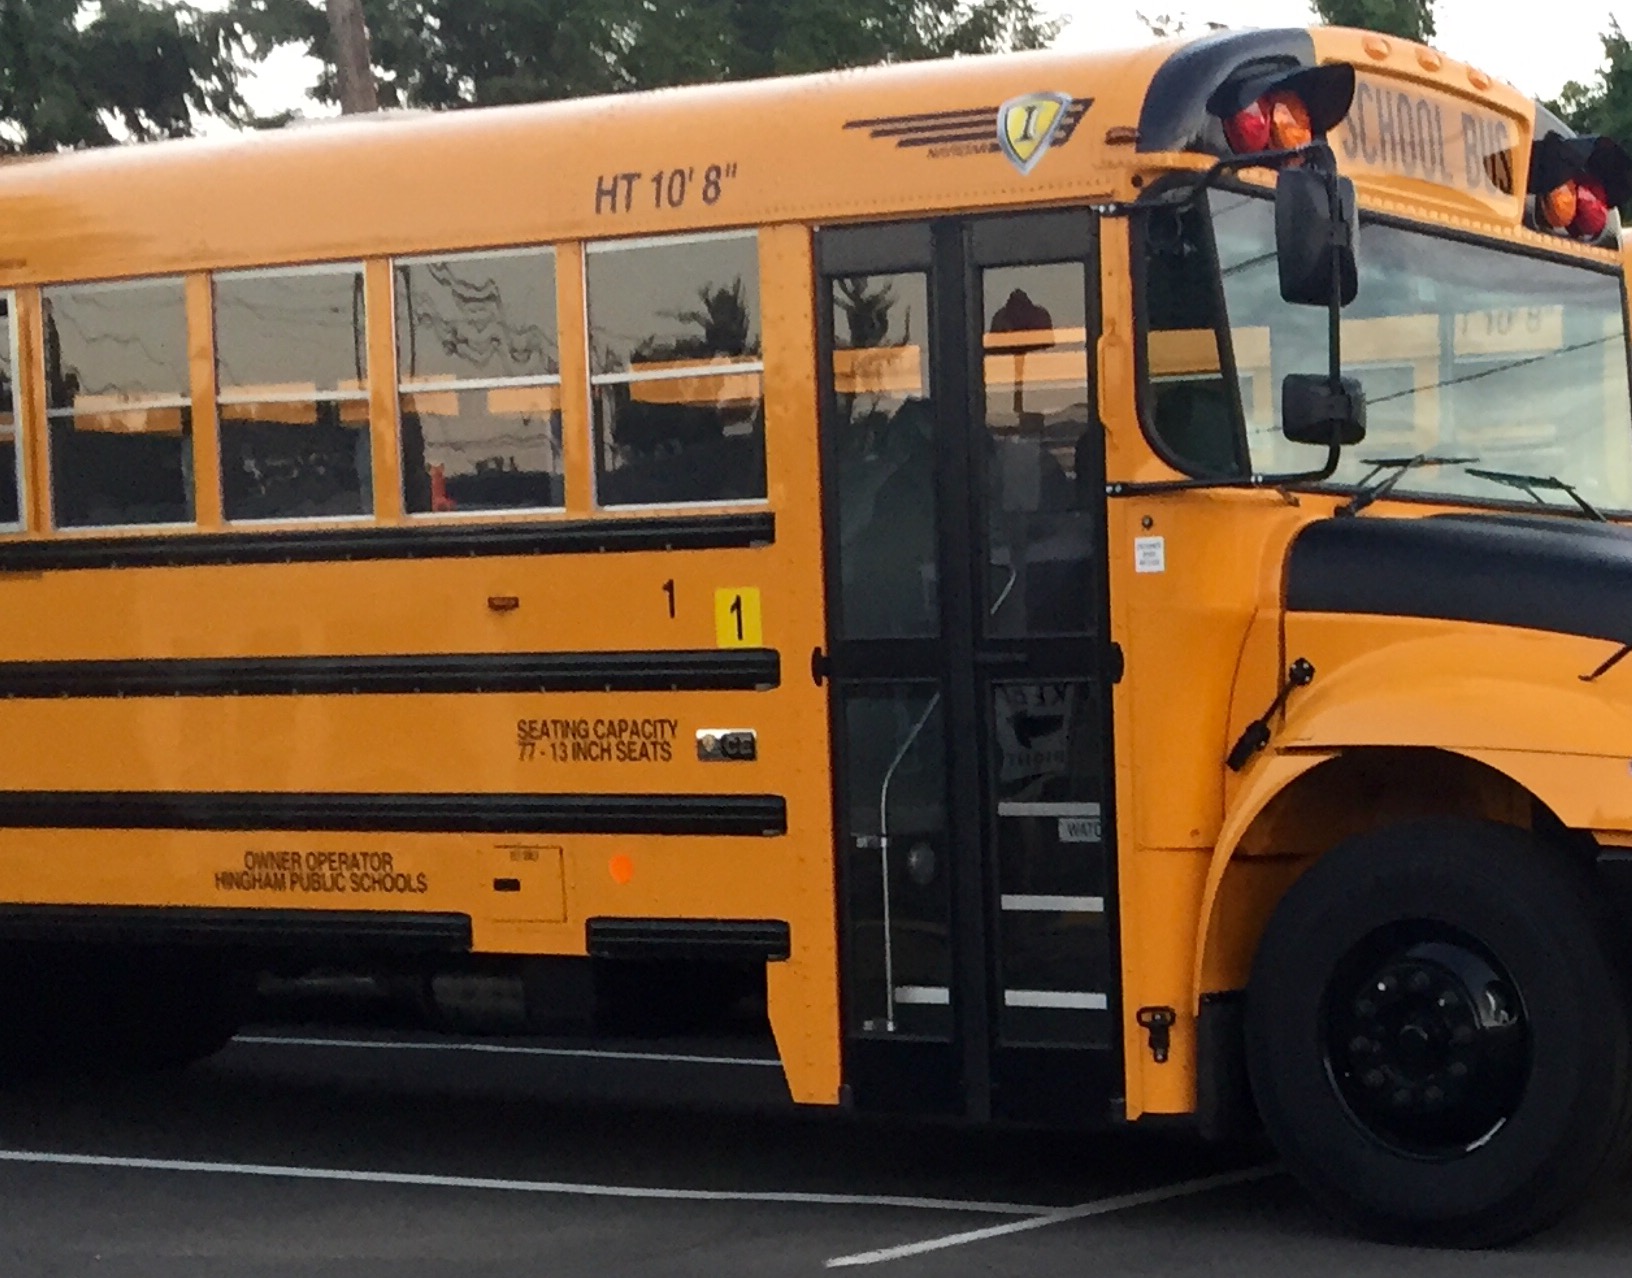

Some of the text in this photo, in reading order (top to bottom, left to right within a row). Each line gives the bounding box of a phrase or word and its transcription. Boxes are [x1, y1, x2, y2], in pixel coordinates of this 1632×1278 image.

[1343, 81, 1515, 195] SCHOOL BUS
[595, 162, 738, 215] HT 10' 8"
[662, 578, 676, 619] 1
[730, 594, 744, 641] 1
[517, 719, 678, 741] SEATING CAPACITY
[518, 741, 536, 762] 77
[550, 742, 568, 762] 13
[571, 742, 612, 762] INCH
[616, 742, 673, 762] SEATS
[244, 851, 394, 872] OWNER OPERATOR
[215, 872, 429, 894] HINGHAM PUBLIC SCHOOLS
